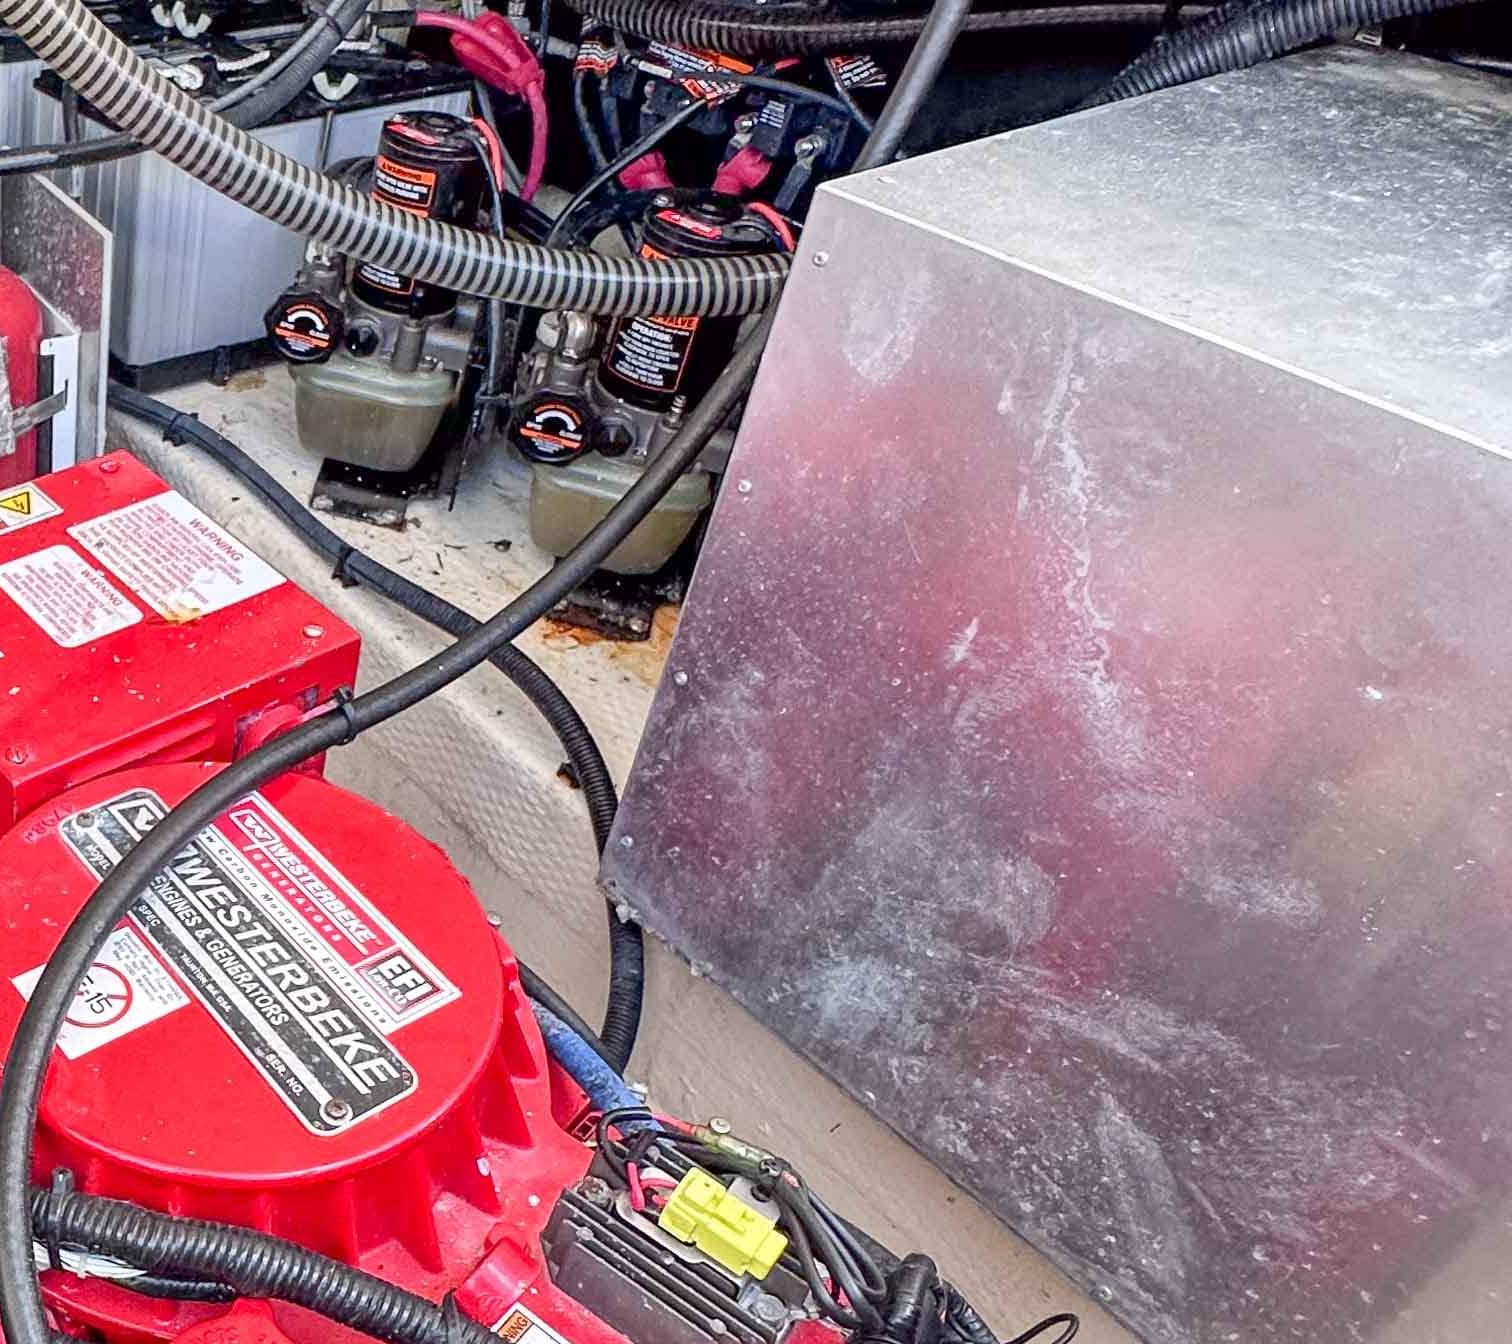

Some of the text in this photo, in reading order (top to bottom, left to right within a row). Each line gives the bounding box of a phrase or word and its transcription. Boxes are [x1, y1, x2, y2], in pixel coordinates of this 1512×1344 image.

[188, 517, 244, 562] WARNING
[81, 569, 124, 607] WARNING
[138, 904, 161, 927] SPEC
[270, 843, 377, 944] WESTERBEKE
[150, 875, 290, 1026] ENGINES & GENERATORS
[218, 848, 258, 889] Carbon
[262, 893, 318, 951] Monoxide
[321, 957, 387, 1024] Emissions
[174, 858, 401, 1087] WESTERBEKE
[380, 954, 433, 1001] EFI
[265, 1052, 304, 1097] SER. NO.
